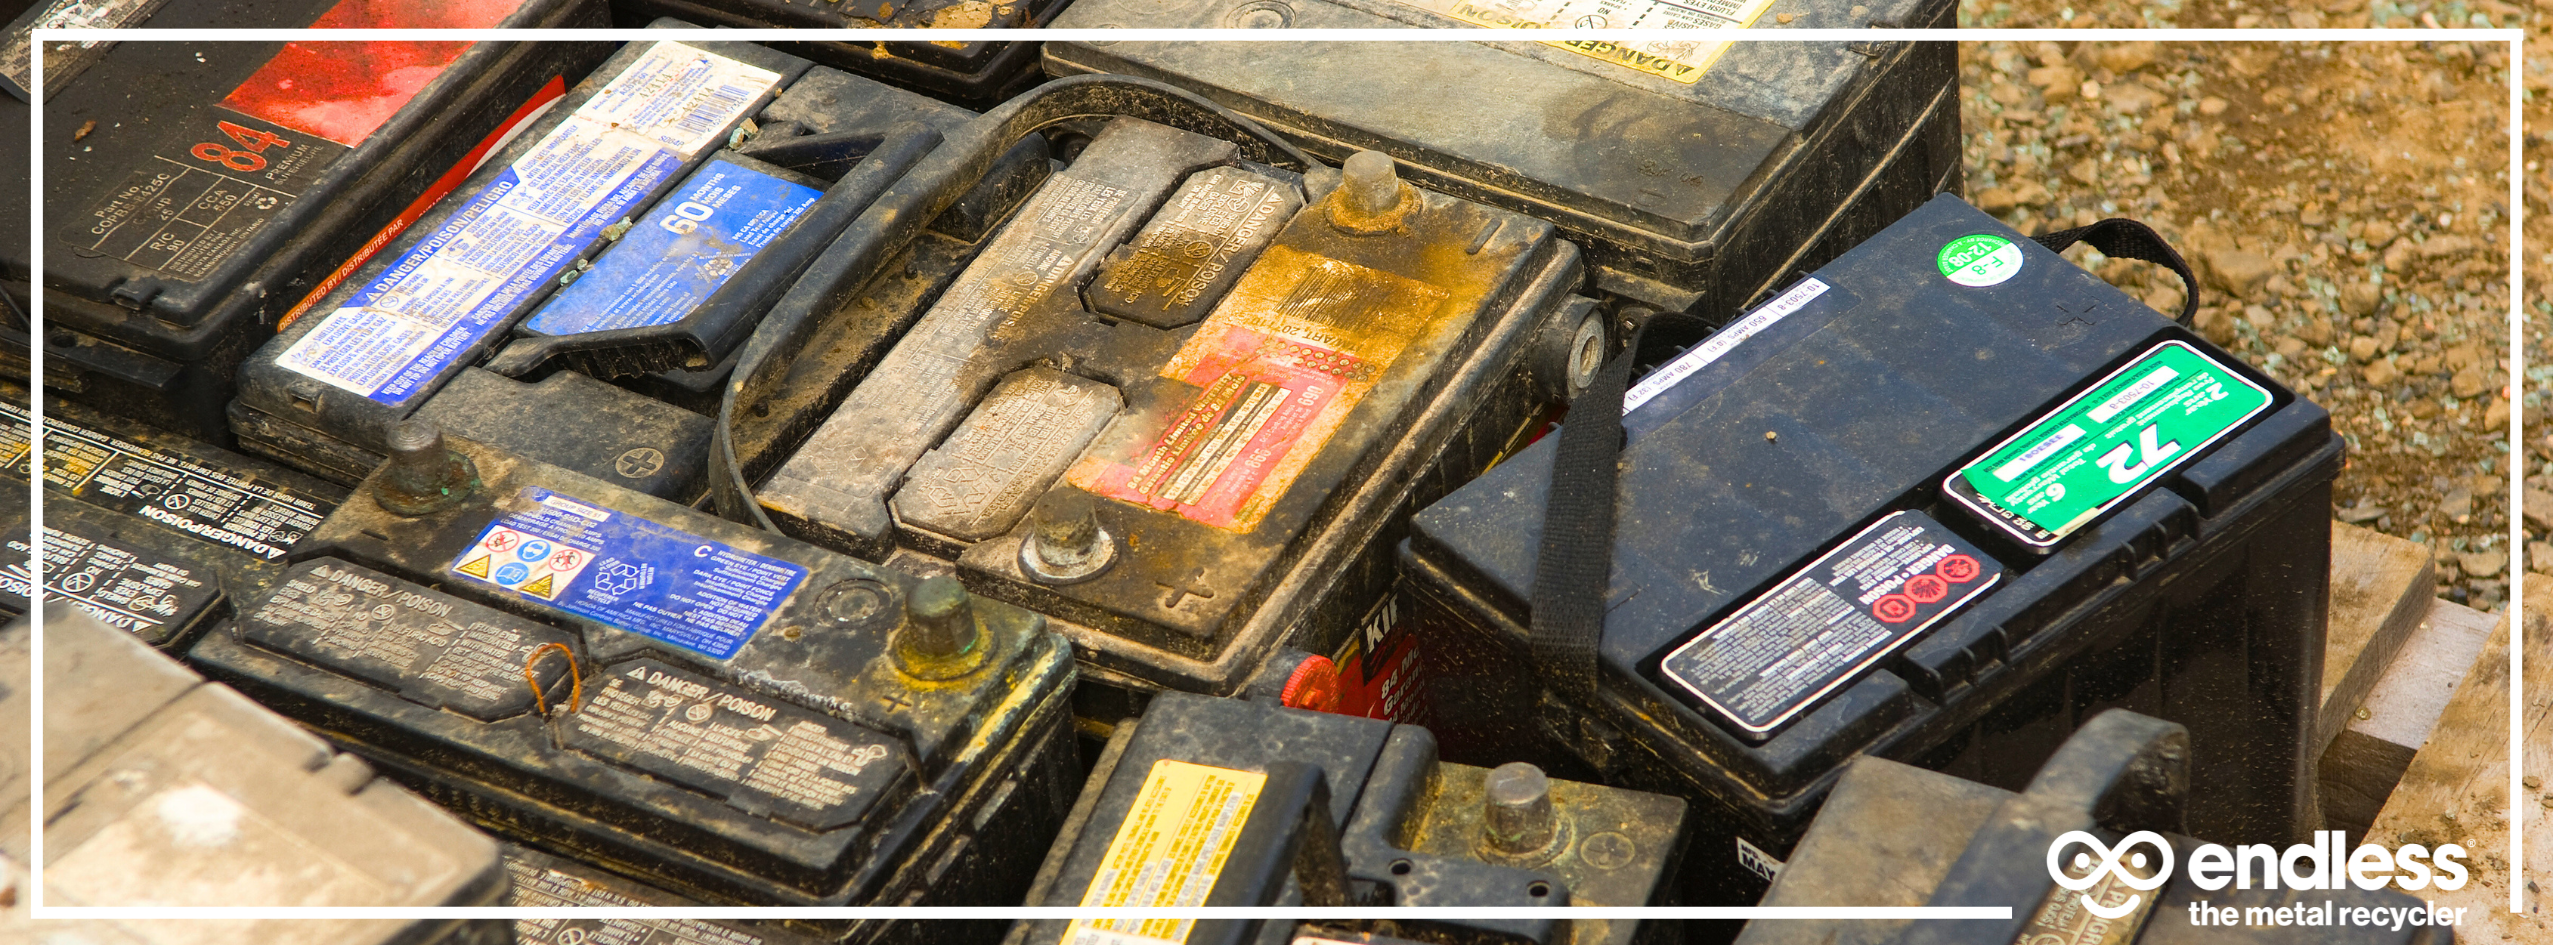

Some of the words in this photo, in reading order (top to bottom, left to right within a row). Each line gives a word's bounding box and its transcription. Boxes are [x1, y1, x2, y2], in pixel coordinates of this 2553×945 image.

[1598, 8, 1610, 16] NO
[191, 120, 291, 172] 84
[588, 137, 604, 146] LES
[263, 144, 312, 179] PREMIUM
[519, 158, 539, 171] FLUSH
[533, 149, 550, 159] EYES
[526, 178, 542, 187] GET
[535, 161, 562, 180] MEDICAL
[555, 152, 573, 163] HELP
[524, 167, 541, 178] WITH
[525, 200, 542, 211] YEUX
[537, 190, 555, 201] AVEC
[569, 156, 594, 174] APPELER
[687, 172, 726, 201] MONTHS
[93, 199, 123, 218] Part
[118, 183, 143, 199] No.
[196, 188, 228, 210] CCA
[699, 186, 725, 204] MOIS
[710, 184, 743, 208] MESES
[1196, 191, 1220, 210] GASES
[659, 200, 715, 235] 60
[1196, 194, 1230, 225] EXPLOSIVE
[1208, 210, 1227, 225] EYES
[373, 180, 515, 292] DANGER/POISON/PELIGRO
[738, 231, 755, 242] Load
[746, 233, 765, 245] Essai
[765, 213, 787, 228] charge
[1222, 204, 1275, 253] DANGER
[148, 232, 176, 250] R/C
[166, 239, 186, 251] 90
[753, 232, 775, 247] Prueba
[1948, 240, 1992, 267] 12-08
[280, 284, 326, 332] DISTRIBUTED
[327, 276, 338, 290] BY
[388, 219, 404, 238] PAR
[1972, 256, 2003, 276] F-8
[1175, 261, 1223, 306] POISON
[321, 323, 352, 345] EXPLOSIVE
[346, 309, 368, 324] GASES
[329, 316, 347, 327] EYES
[371, 316, 387, 326] GAZ
[1748, 314, 1766, 327] 650
[367, 354, 382, 364] LOS
[391, 329, 412, 344] GASES
[1673, 360, 1692, 373] 780
[2195, 371, 2210, 380] de
[2191, 375, 2216, 391] Free
[2204, 381, 2230, 400] 2
[1296, 384, 1323, 406] 690
[2134, 377, 2199, 420] remplacement
[2181, 390, 2207, 407] ans
[2134, 388, 2195, 427] Replacement
[2182, 396, 2213, 416] Year
[79, 427, 109, 442] GARDER
[1137, 456, 1176, 494] Garantie
[1198, 411, 1215, 423] de
[1209, 398, 1226, 411] 84
[1220, 374, 1247, 398] Mois
[2103, 416, 2137, 439] gratuit
[150, 451, 167, 461] PAS
[1125, 474, 1144, 489] 84
[1136, 445, 1169, 475] Month
[1162, 411, 1198, 445] Limited
[2082, 443, 2097, 452] de
[2096, 426, 2181, 484] 72
[165, 456, 178, 465] NE
[2040, 450, 2084, 478] garantie
[2058, 457, 2086, 475] Total
[68, 472, 81, 481] LES
[210, 471, 226, 481] DES
[252, 485, 264, 493] LA
[261, 488, 273, 496] DE
[273, 491, 295, 503] HORS
[2003, 476, 2042, 502] globale
[2008, 473, 2060, 507] Warranty
[2025, 491, 2047, 505] ans
[2046, 482, 2067, 502] 6
[293, 497, 316, 510] TENIR
[575, 507, 593, 515] SIZE
[2024, 498, 2051, 515] Year
[137, 503, 271, 555] DANGER/POISON
[259, 524, 275, 534] LES
[499, 518, 517, 526] LOAD
[582, 529, 602, 538] AMPS
[585, 535, 605, 544] AMPS
[691, 543, 714, 559] C
[1904, 542, 1956, 576] DANGER
[84, 564, 102, 577] NO
[709, 555, 735, 566] GREEN
[749, 566, 771, 576] POINT
[769, 572, 790, 582] VERT
[723, 565, 760, 579] Sufficiently
[758, 575, 787, 587] Charged
[285, 578, 317, 594] SHIELD
[692, 569, 713, 578] DARK
[730, 580, 753, 590] POINT
[277, 586, 301, 599] EYES
[328, 568, 392, 598] DANGER
[395, 590, 452, 618] POISON
[743, 590, 772, 601] Charged
[1857, 573, 1906, 606] POISON
[574, 599, 598, 609] HONDA
[604, 608, 634, 620] AMERICA
[678, 596, 695, 605] NOT
[694, 601, 714, 610] OPEN
[725, 610, 742, 618] NOT
[696, 590, 727, 603] ADDITION
[736, 602, 762, 613] WATER
[351, 609, 369, 621] NO
[642, 604, 657, 612] PAS
[693, 619, 709, 627] PAS
[474, 622, 501, 636] FLUSH
[423, 634, 447, 648] ACID
[452, 645, 469, 656] GET
[459, 638, 481, 650] WITH
[607, 677, 623, 688] SE
[1382, 668, 1398, 700] 84
[591, 695, 610, 706] LES
[607, 700, 630, 713] YEUX
[646, 671, 710, 700] DANGER
[716, 694, 776, 722] POISON
[1742, 852, 1776, 880] MAY
